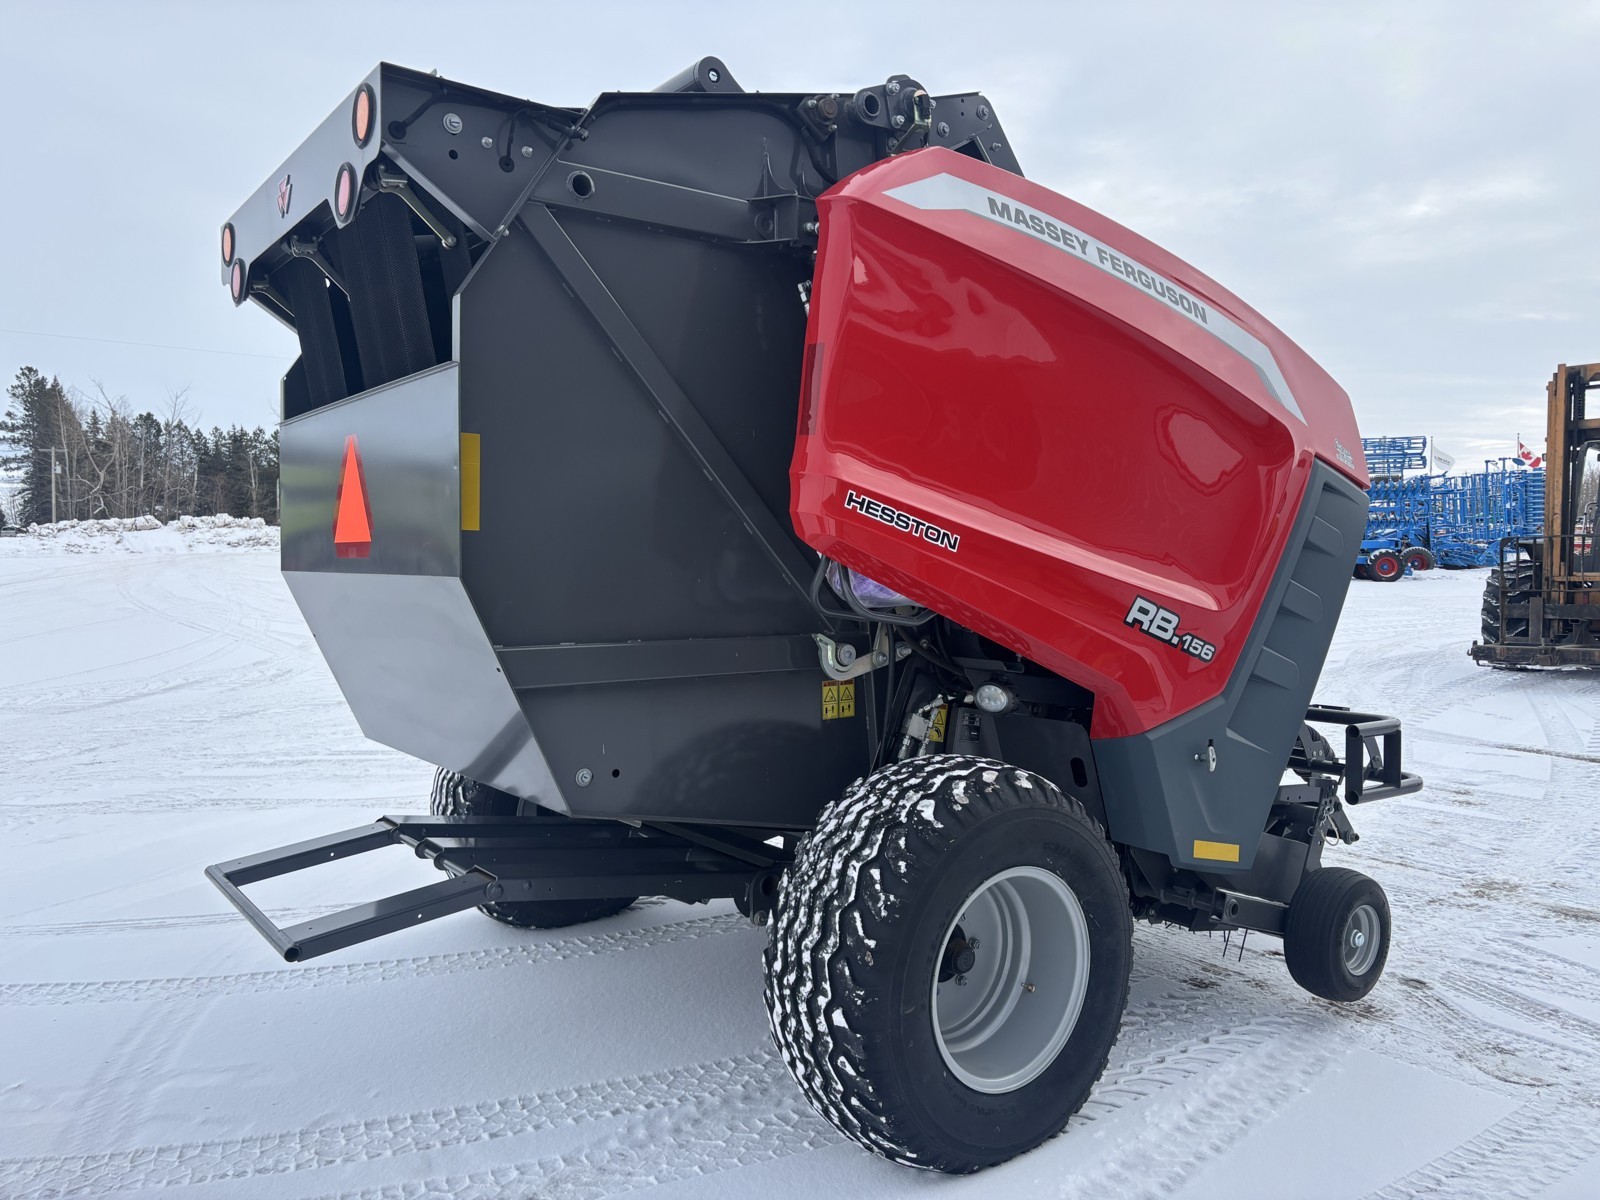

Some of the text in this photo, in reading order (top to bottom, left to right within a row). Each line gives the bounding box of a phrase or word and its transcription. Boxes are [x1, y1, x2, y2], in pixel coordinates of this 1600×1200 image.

[987, 197, 1208, 325] MASSEY FERGUSON
[845, 490, 960, 552] HESSTON
